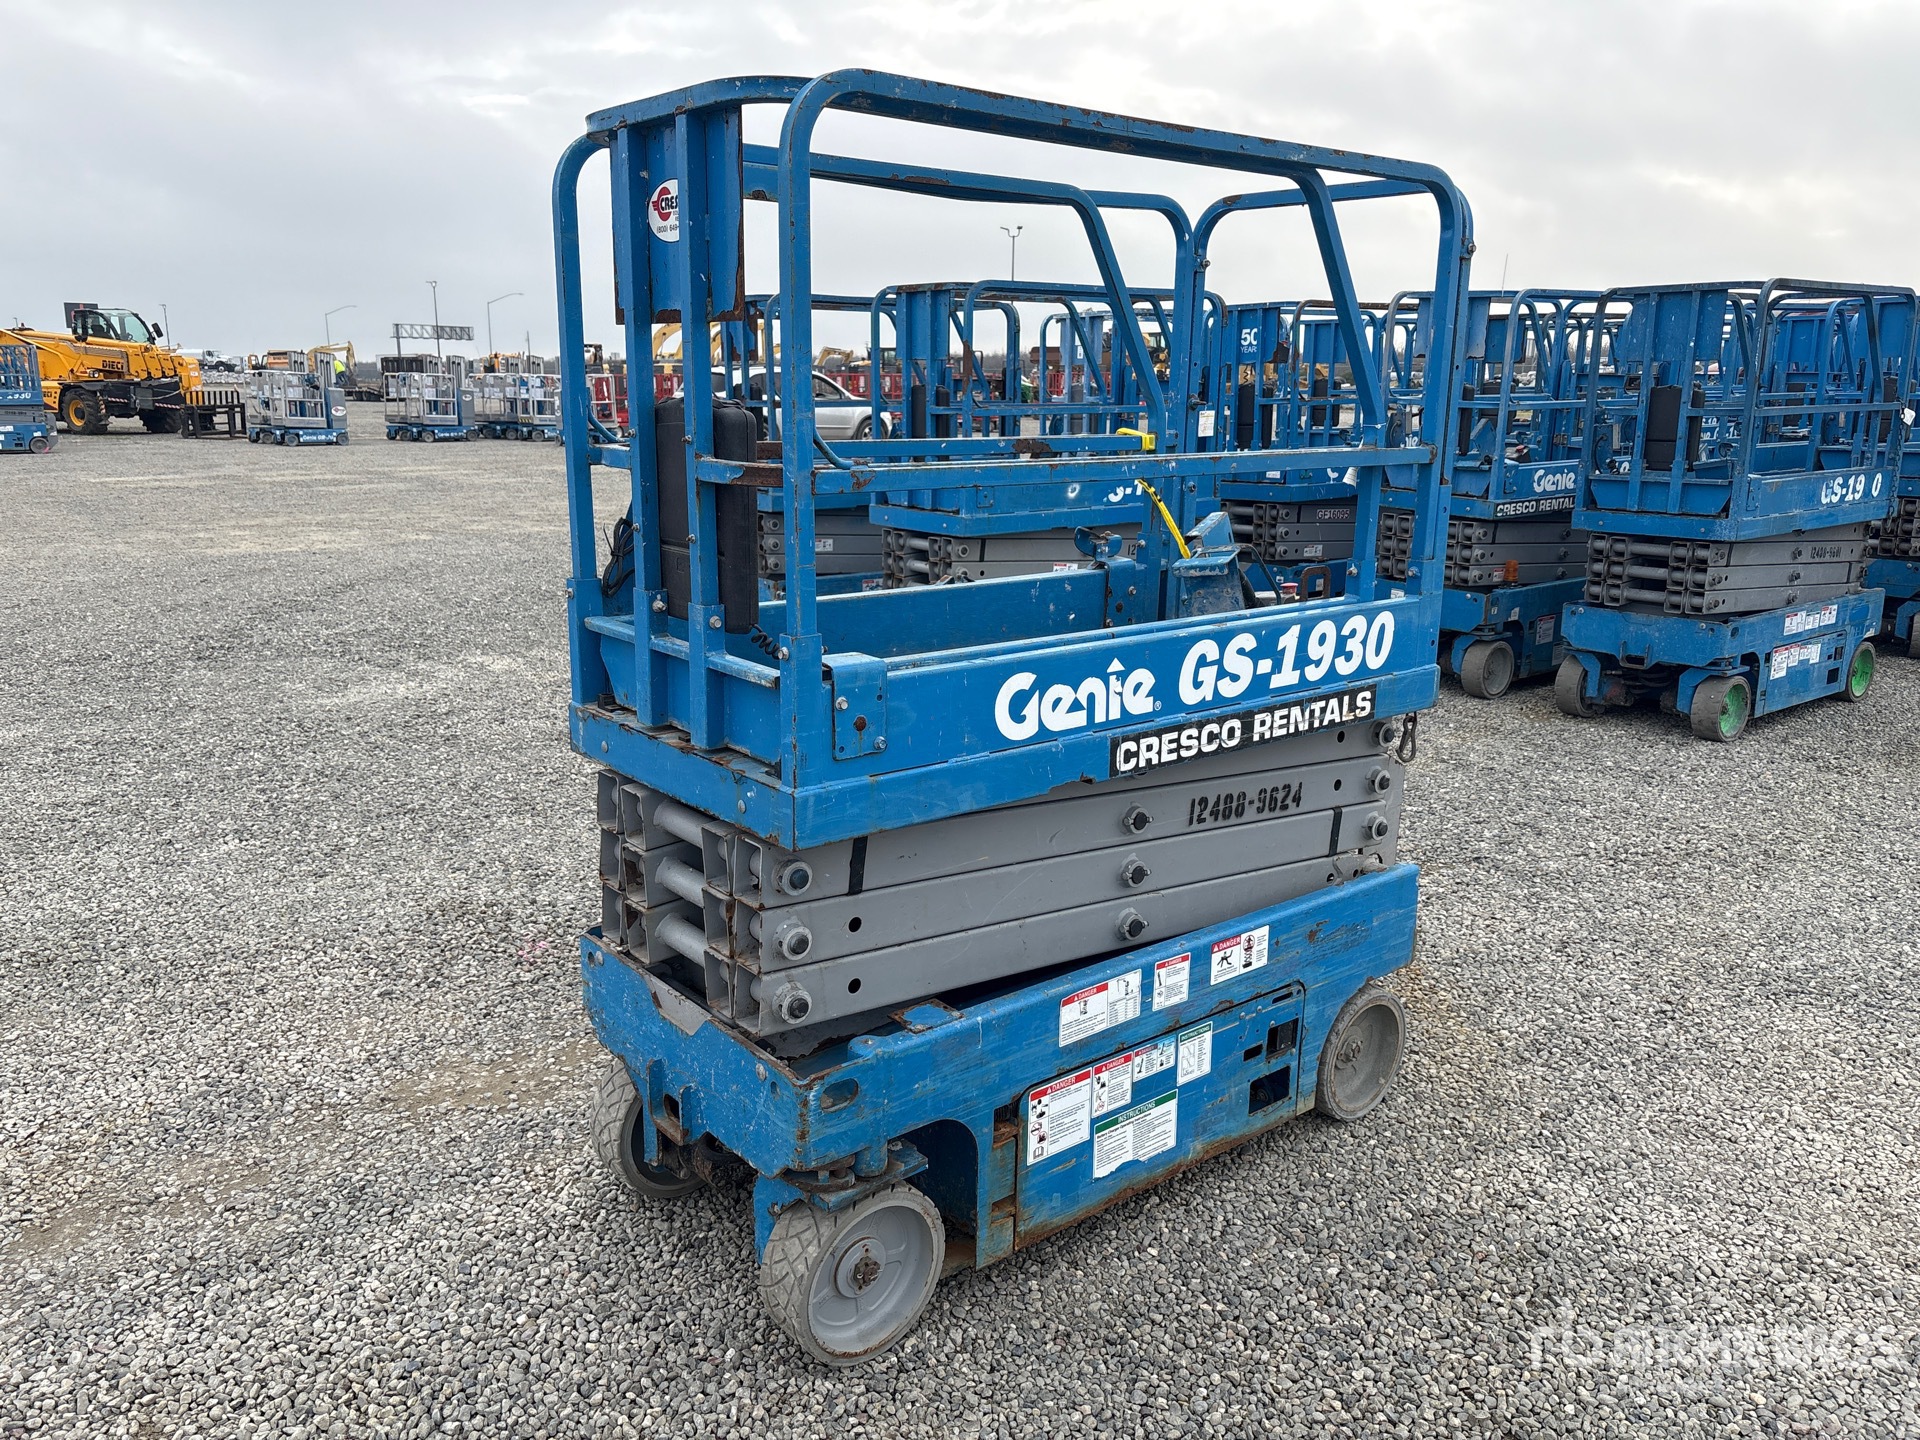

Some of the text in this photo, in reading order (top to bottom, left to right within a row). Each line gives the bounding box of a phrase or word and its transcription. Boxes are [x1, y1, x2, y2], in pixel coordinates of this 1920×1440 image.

[101, 360, 125, 371] DIECI
[1533, 468, 1576, 493] Genie
[1496, 501, 1537, 517] CRESCO
[994, 610, 1395, 741] Genie GS-1930
[1115, 690, 1373, 773] CRESCO RENTALS
[1188, 781, 1303, 827] 12488-9624
[1219, 936, 1241, 950] DANGER
[1078, 987, 1098, 999] DANGER
[1106, 1058, 1125, 1070] DANGER
[1052, 1076, 1076, 1092] DANGER
[1117, 1100, 1156, 1123] INSTRUCTIONS
